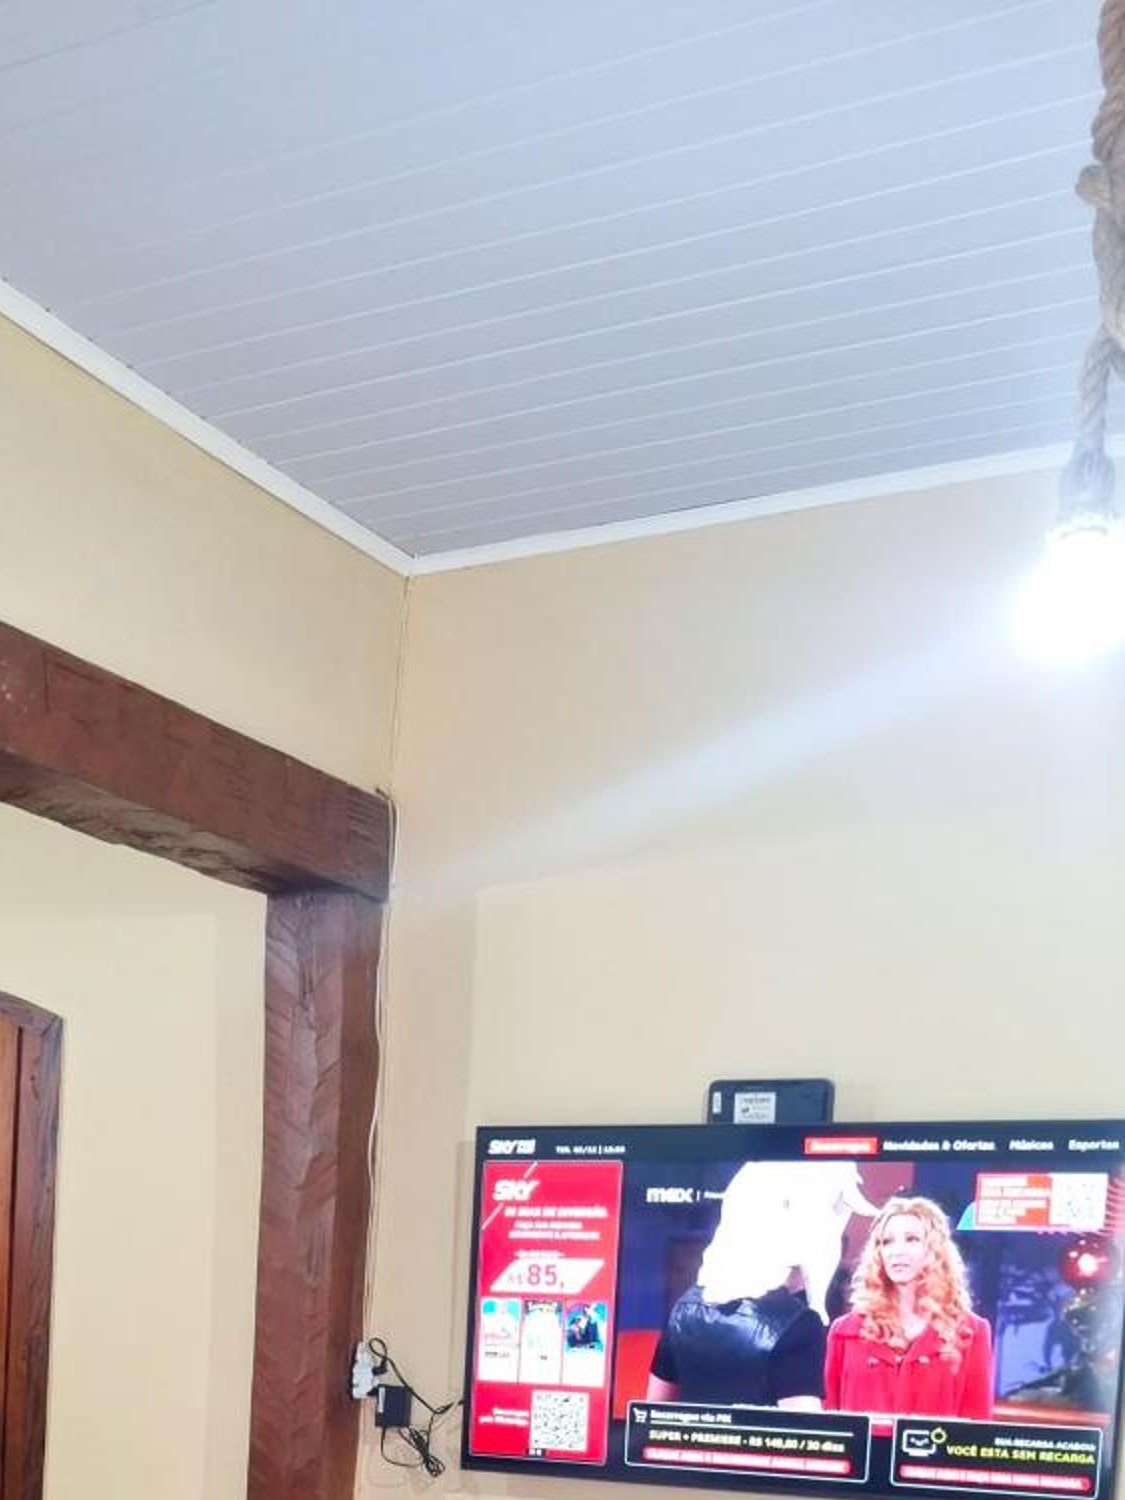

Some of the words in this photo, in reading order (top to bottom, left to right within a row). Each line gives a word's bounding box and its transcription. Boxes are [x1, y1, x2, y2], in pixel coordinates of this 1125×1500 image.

[493, 1179, 539, 1201] SKY
[646, 1187, 694, 1203] max
[650, 1429, 681, 1441] SUPER
[947, 1444, 977, 1457] VOCÊ
[1012, 1449, 1036, 1461] SEM
[1039, 1452, 1095, 1465] RECARGA
